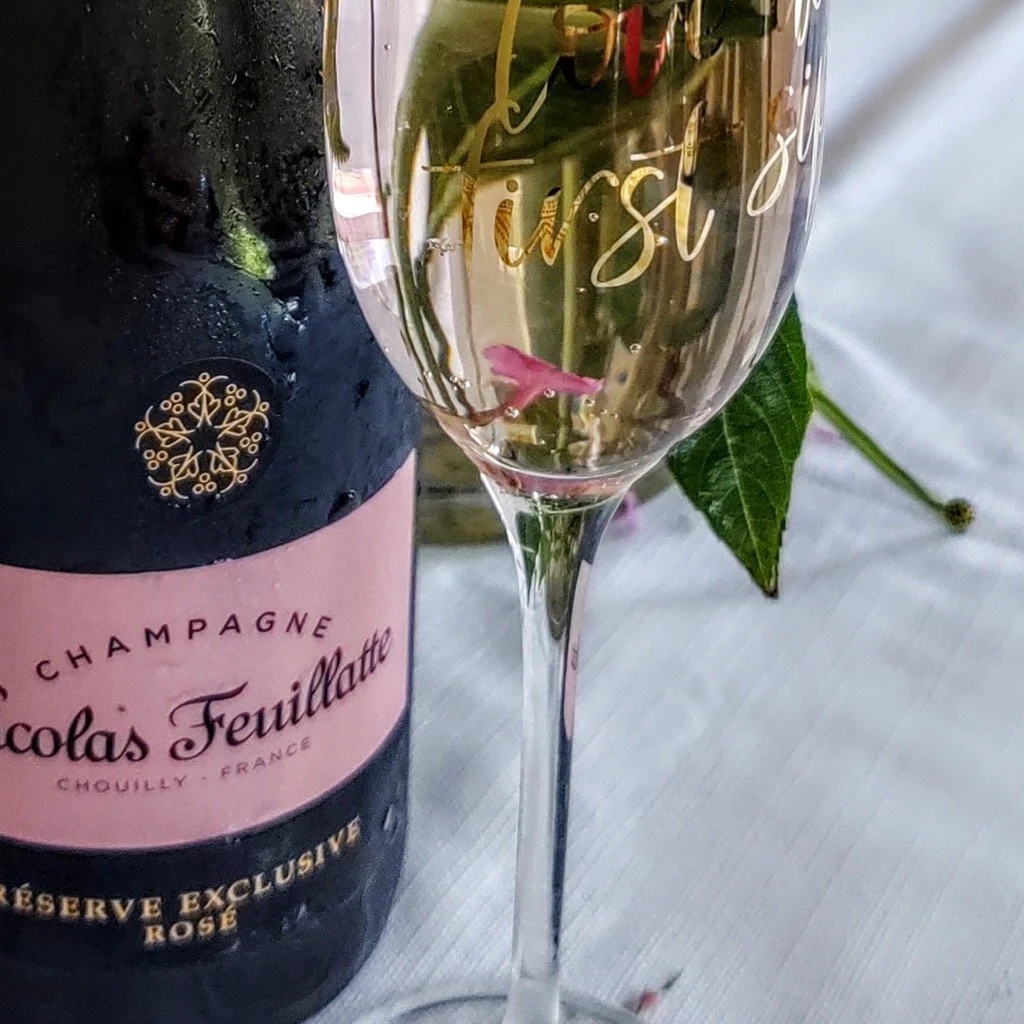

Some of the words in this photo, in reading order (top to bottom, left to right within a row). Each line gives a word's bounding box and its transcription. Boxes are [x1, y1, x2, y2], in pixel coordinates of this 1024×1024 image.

[35, 610, 333, 682] CHAMPAGNE
[168, 626, 393, 762] Feuillatte
[56, 775, 189, 793] CHOUILLY
[220, 736, 313, 779] FRANCE
[178, 815, 364, 916] EXCLUSIVE
[142, 905, 239, 949] ROSÉ
